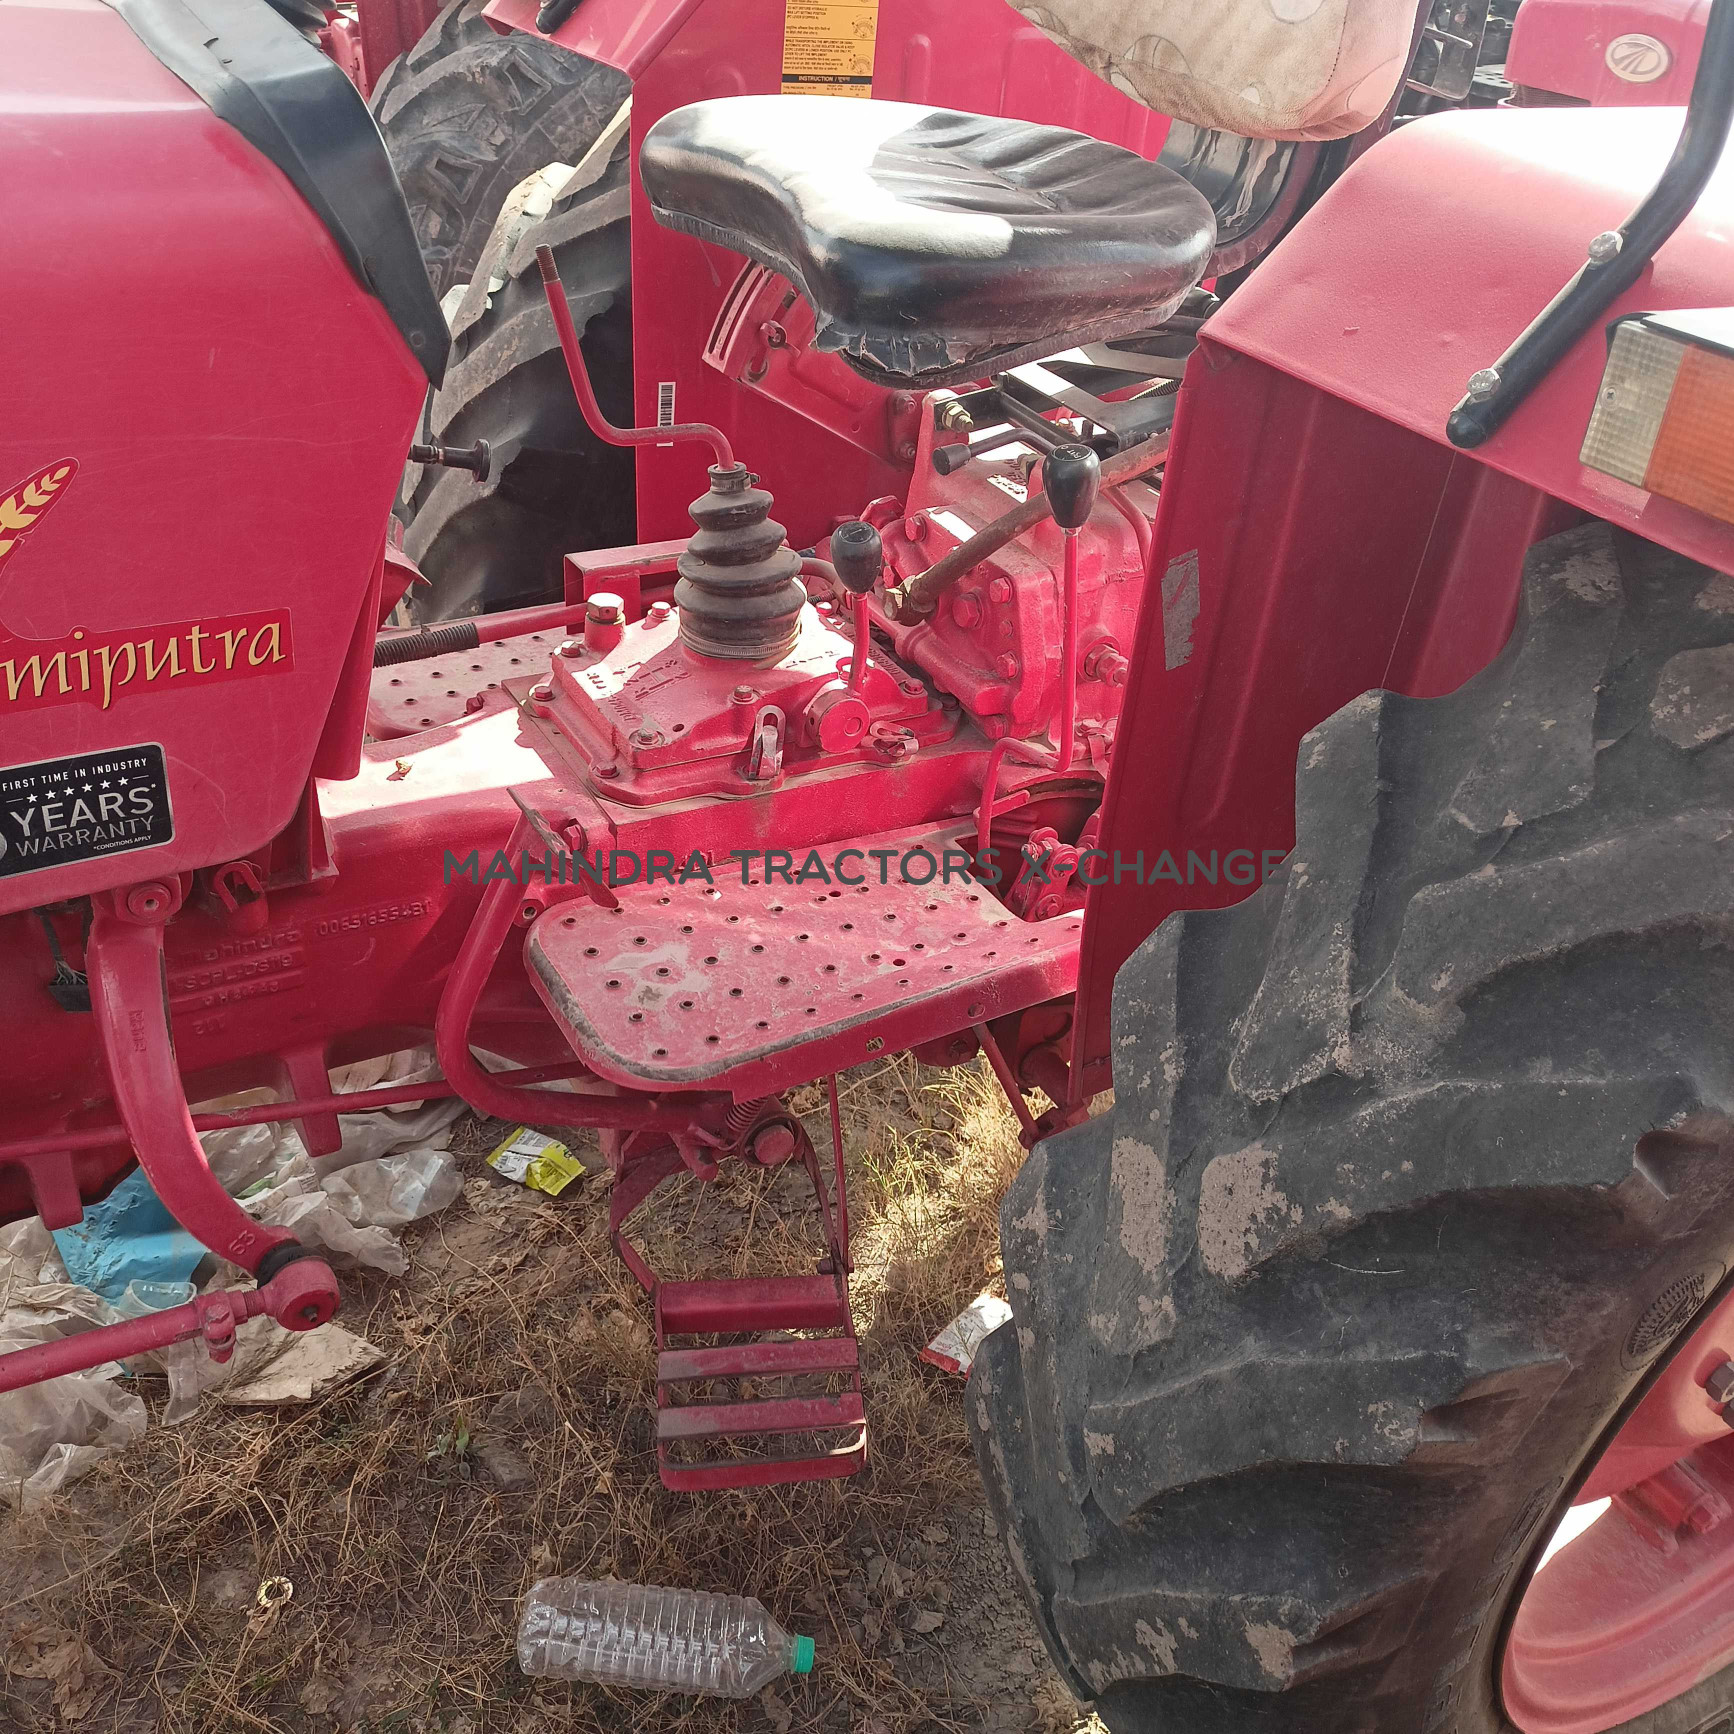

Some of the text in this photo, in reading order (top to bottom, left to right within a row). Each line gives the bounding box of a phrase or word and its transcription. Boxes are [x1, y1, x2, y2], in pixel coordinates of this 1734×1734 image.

[0, 621, 286, 710] miputra
[2, 758, 148, 791] FIRST TIME IN INDUSTRY
[16, 815, 154, 857] WARRANTY
[134, 834, 152, 844] APPLY
